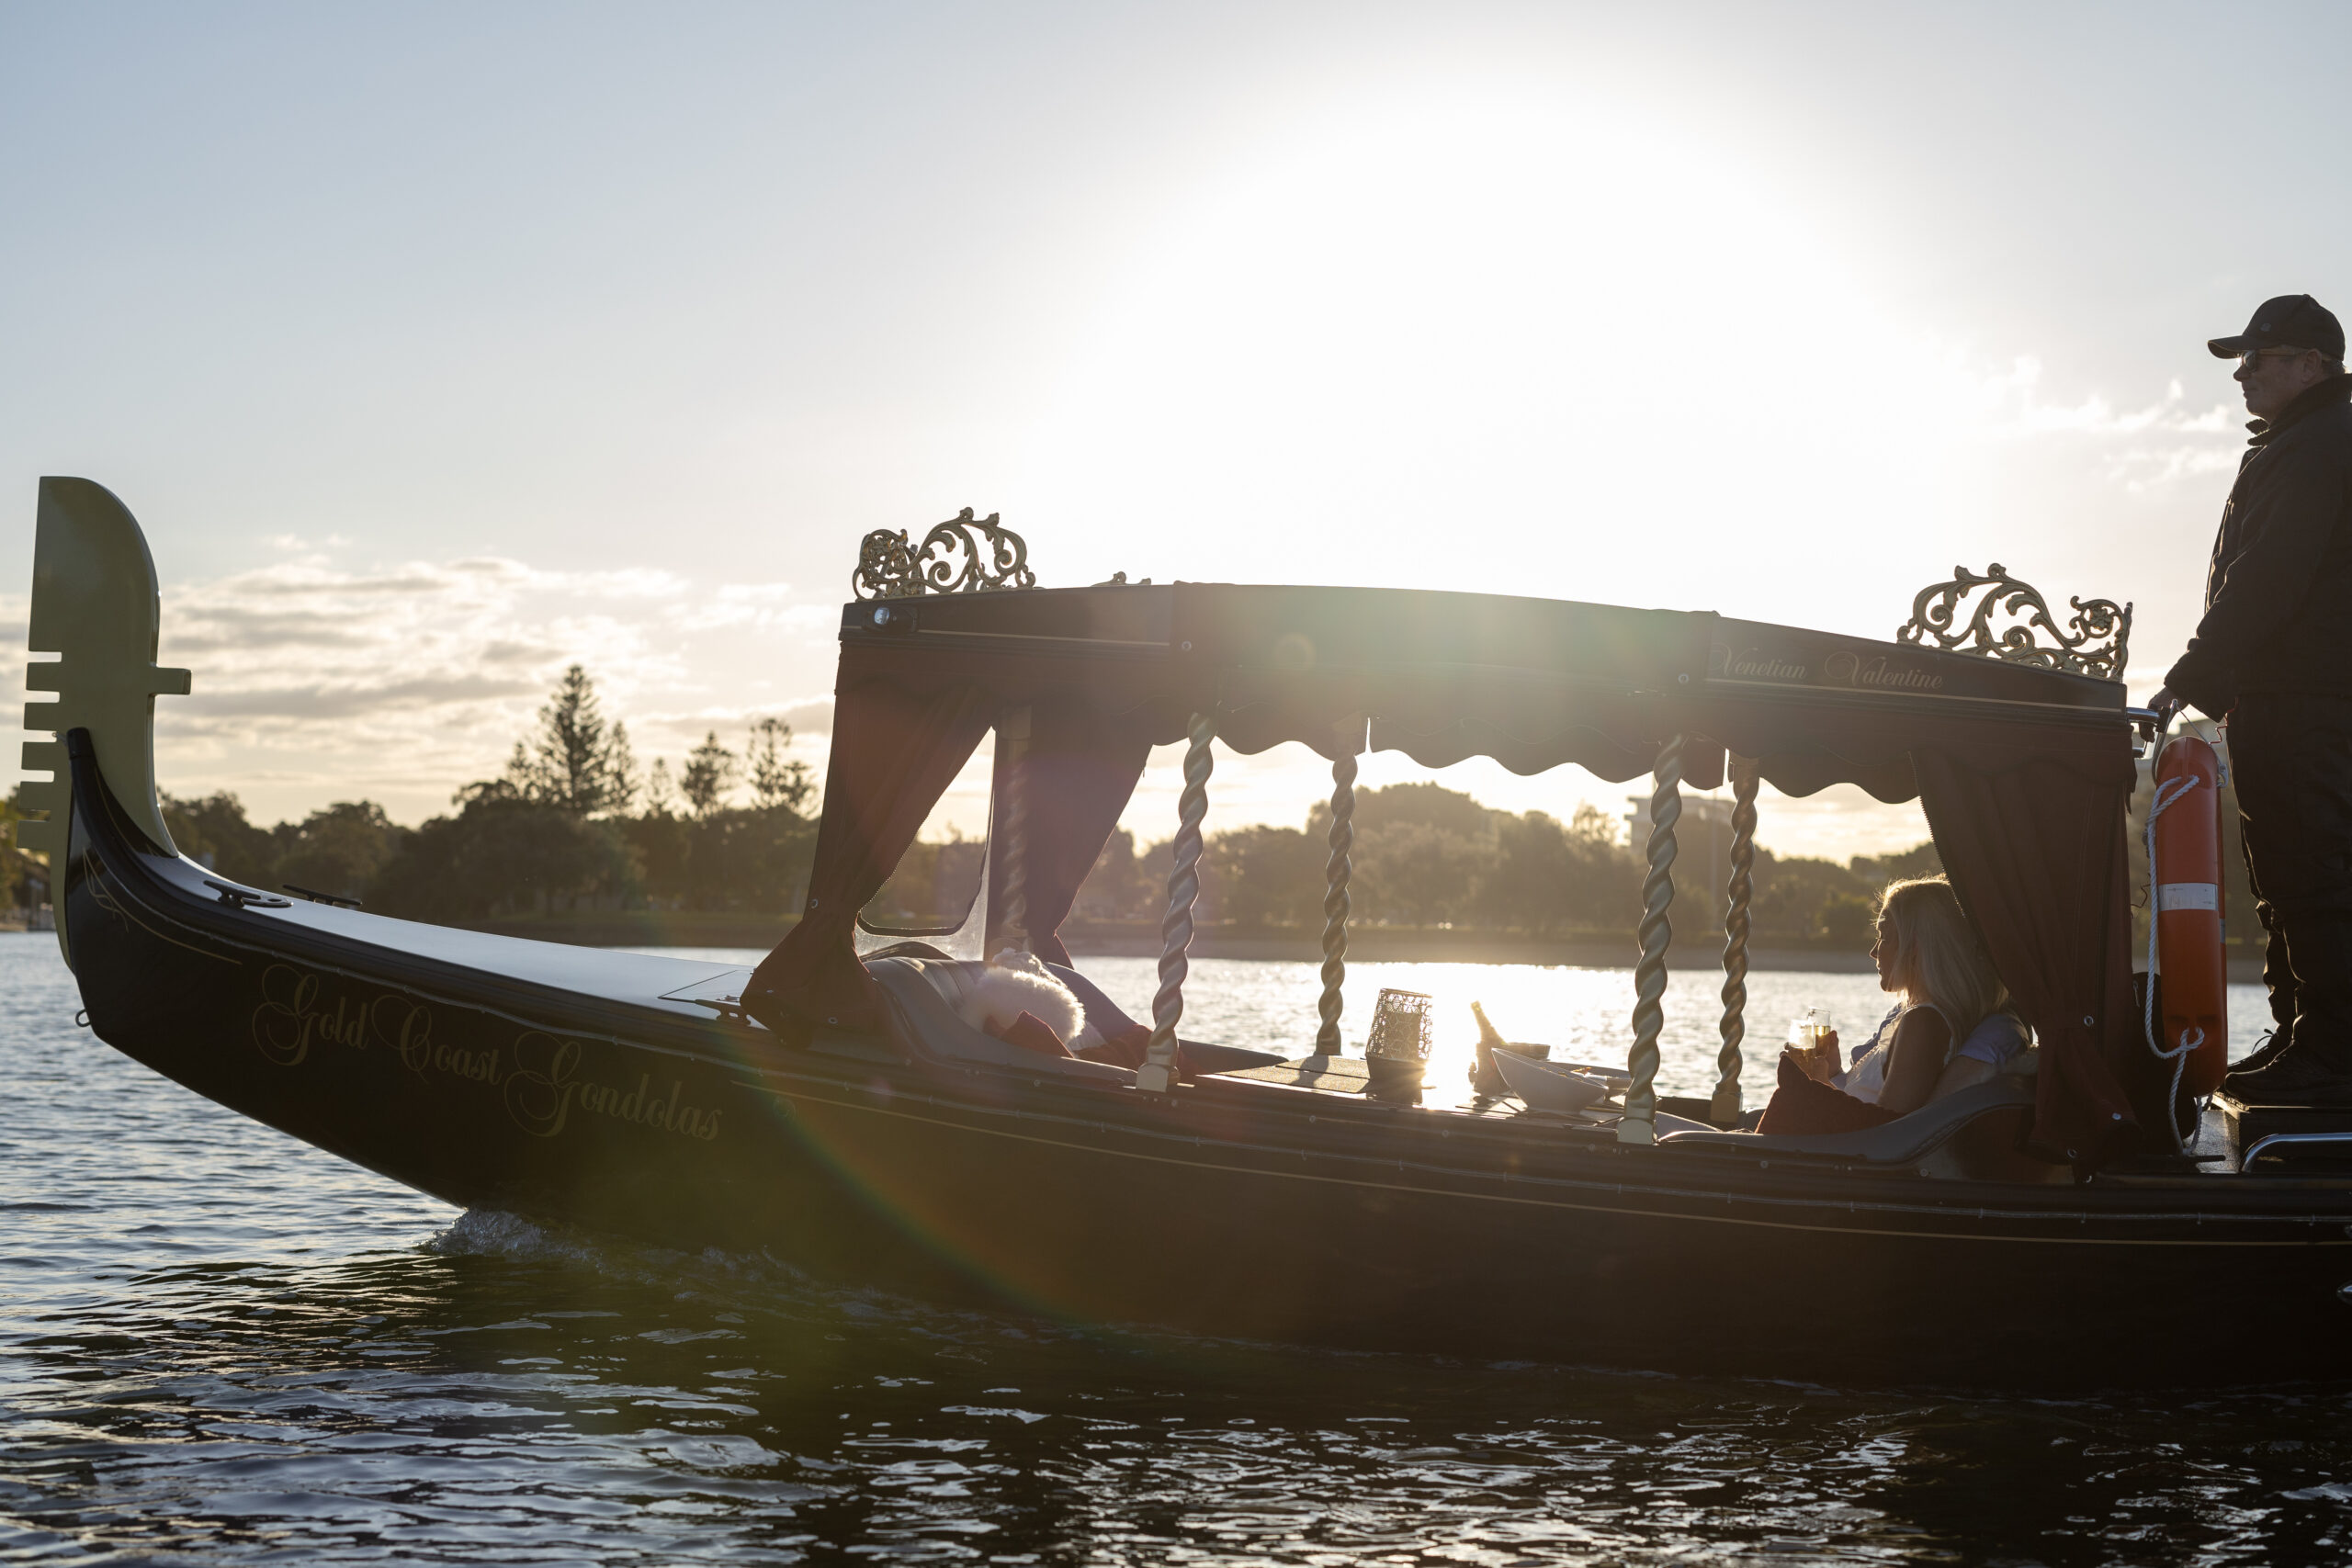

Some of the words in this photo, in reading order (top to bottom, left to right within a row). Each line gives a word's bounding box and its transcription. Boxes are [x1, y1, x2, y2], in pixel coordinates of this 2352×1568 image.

[1710, 643, 1807, 679] Venetian
[1824, 650, 1943, 690] Valentine
[253, 963, 368, 1066] Gold
[371, 994, 503, 1085] Coast
[503, 1030, 723, 1141] Gondolas
